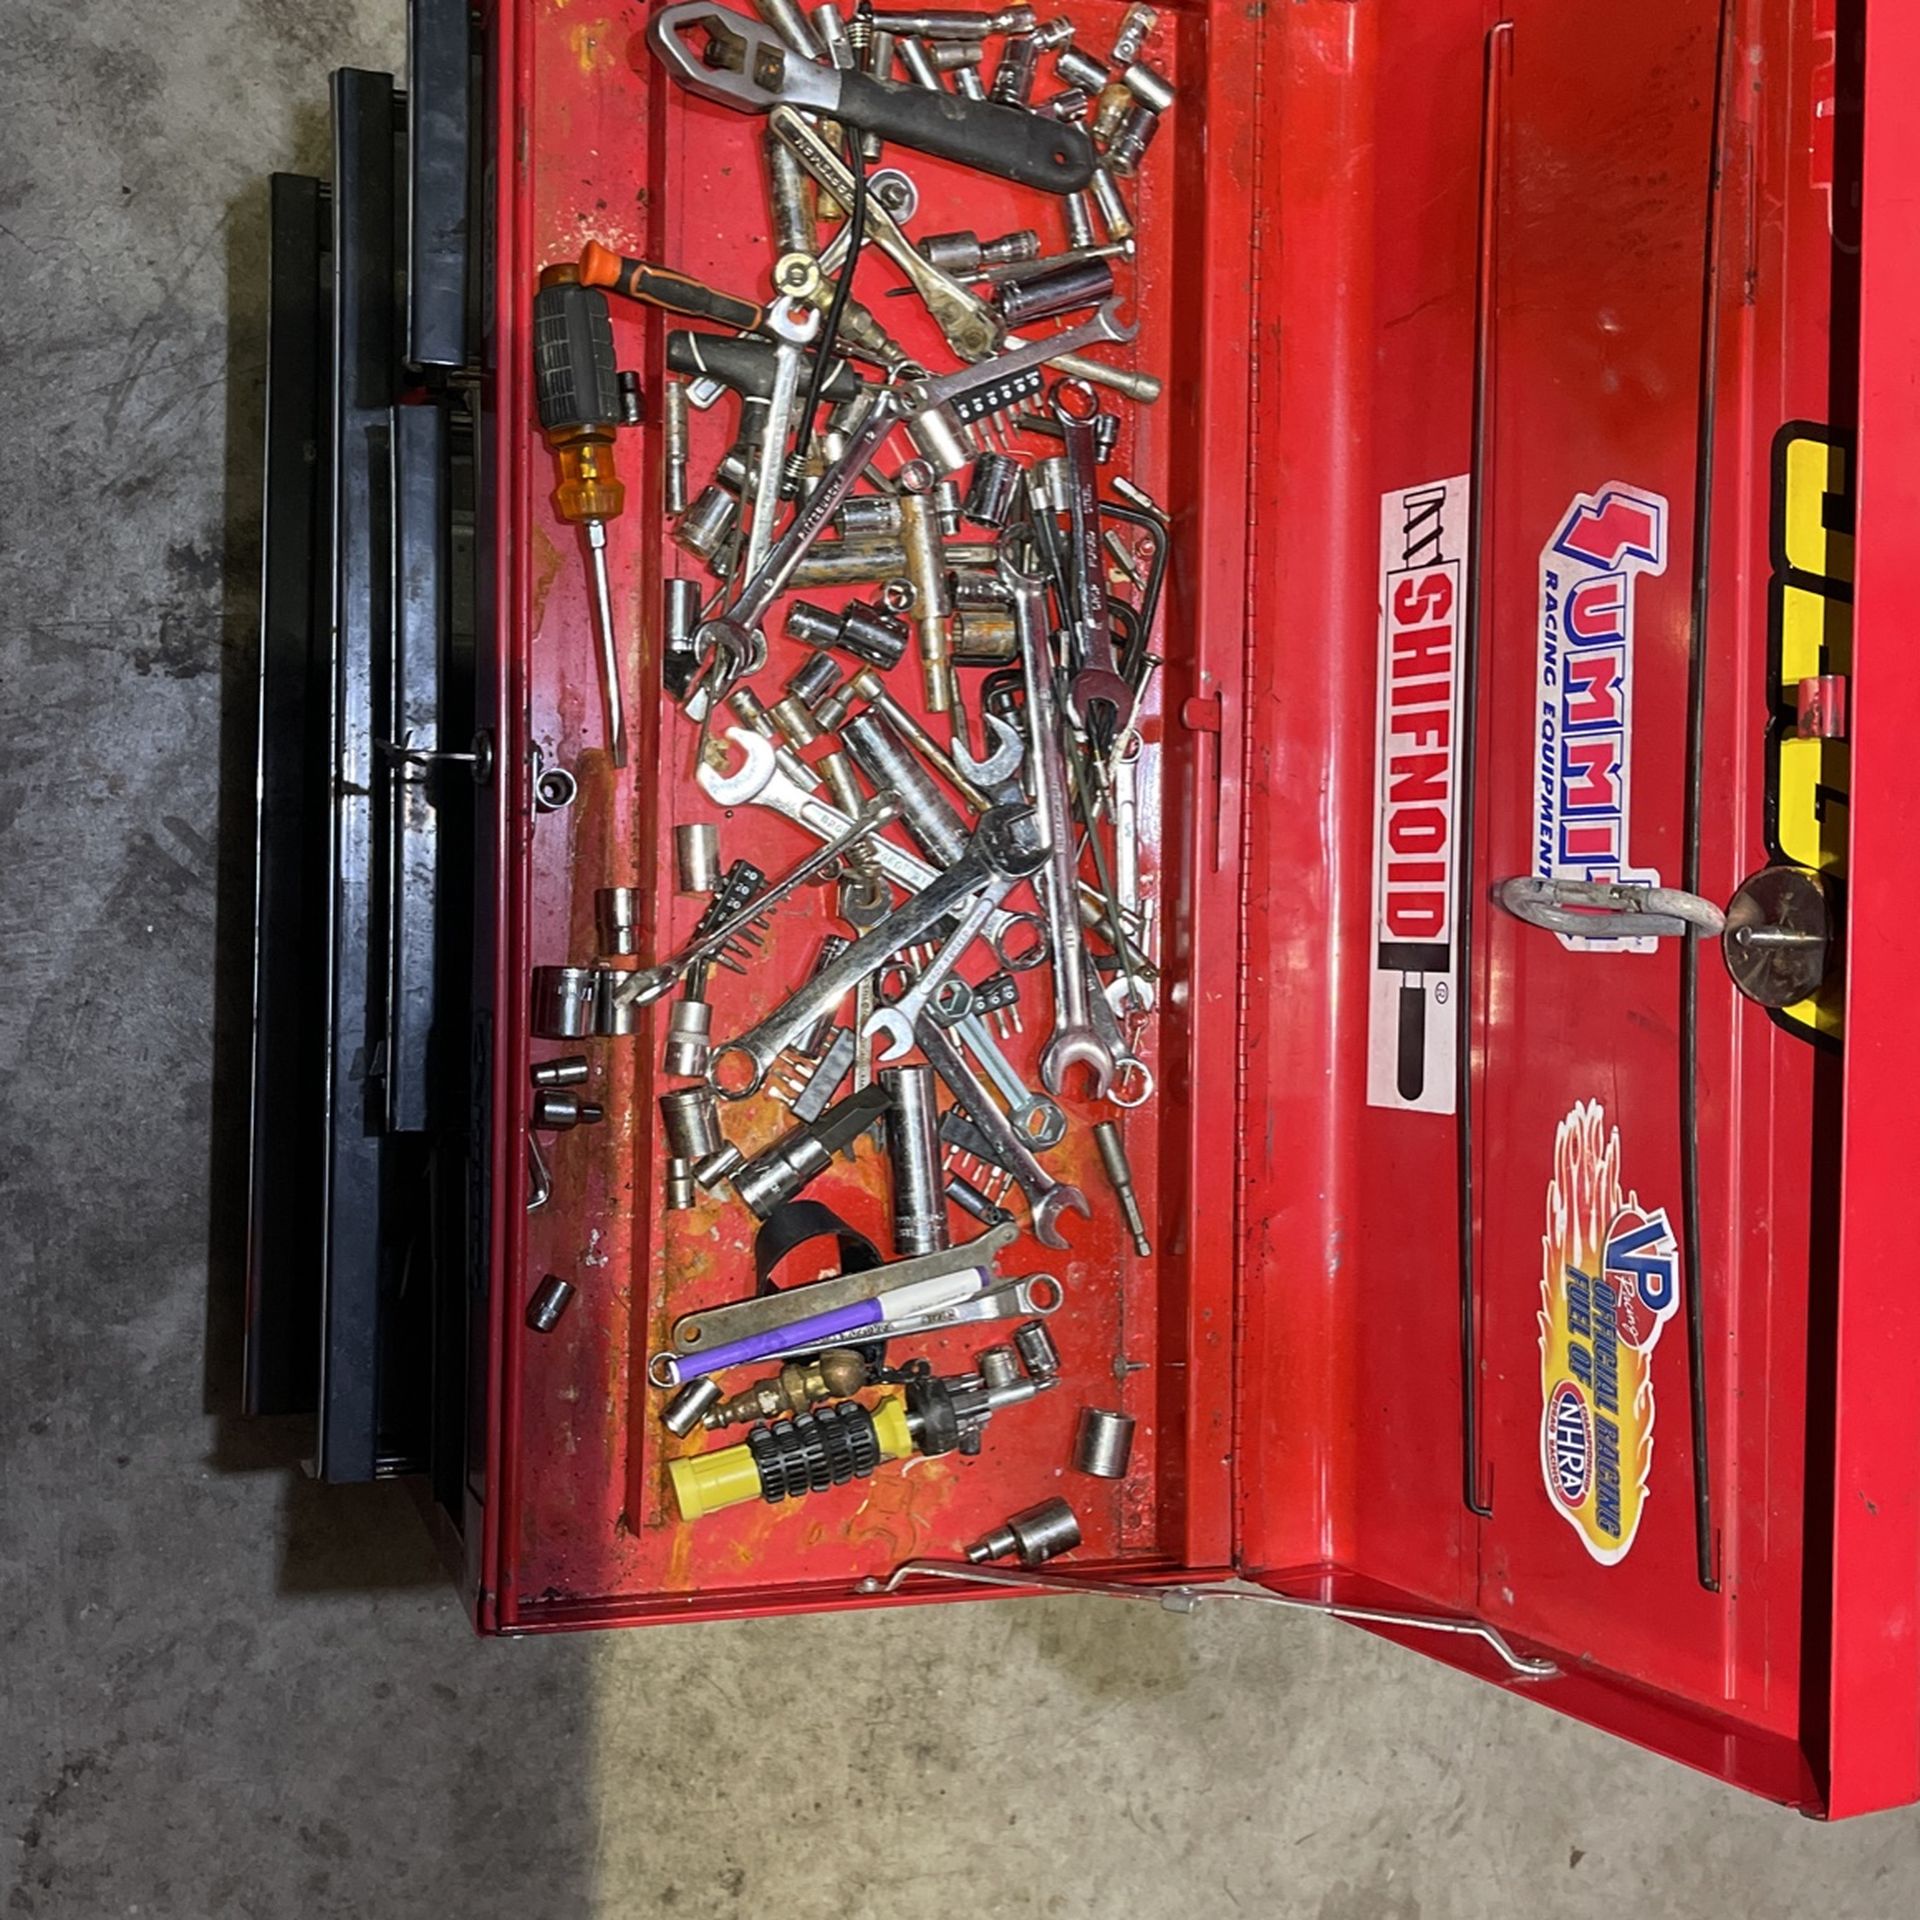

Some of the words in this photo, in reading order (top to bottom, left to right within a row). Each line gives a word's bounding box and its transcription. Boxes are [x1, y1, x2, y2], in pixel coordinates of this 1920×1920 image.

[794, 137, 857, 208] RAFTSMAN
[1543, 569, 1559, 688] RACING
[1386, 573, 1453, 937] SHIFNOID
[1540, 701, 1556, 879] EQUIPMENT
[1566, 1265, 1591, 1337] FUEL
[1605, 1220, 1673, 1312] VP
[1613, 1275, 1640, 1347] Racing
[1568, 1344, 1592, 1388] OF
[1591, 1277, 1619, 1412] OFFICIAL
[1556, 1402, 1584, 1489] NHRA
[1579, 1405, 1593, 1493] CHAMPIONSHIP
[1592, 1414, 1621, 1539] RACING
